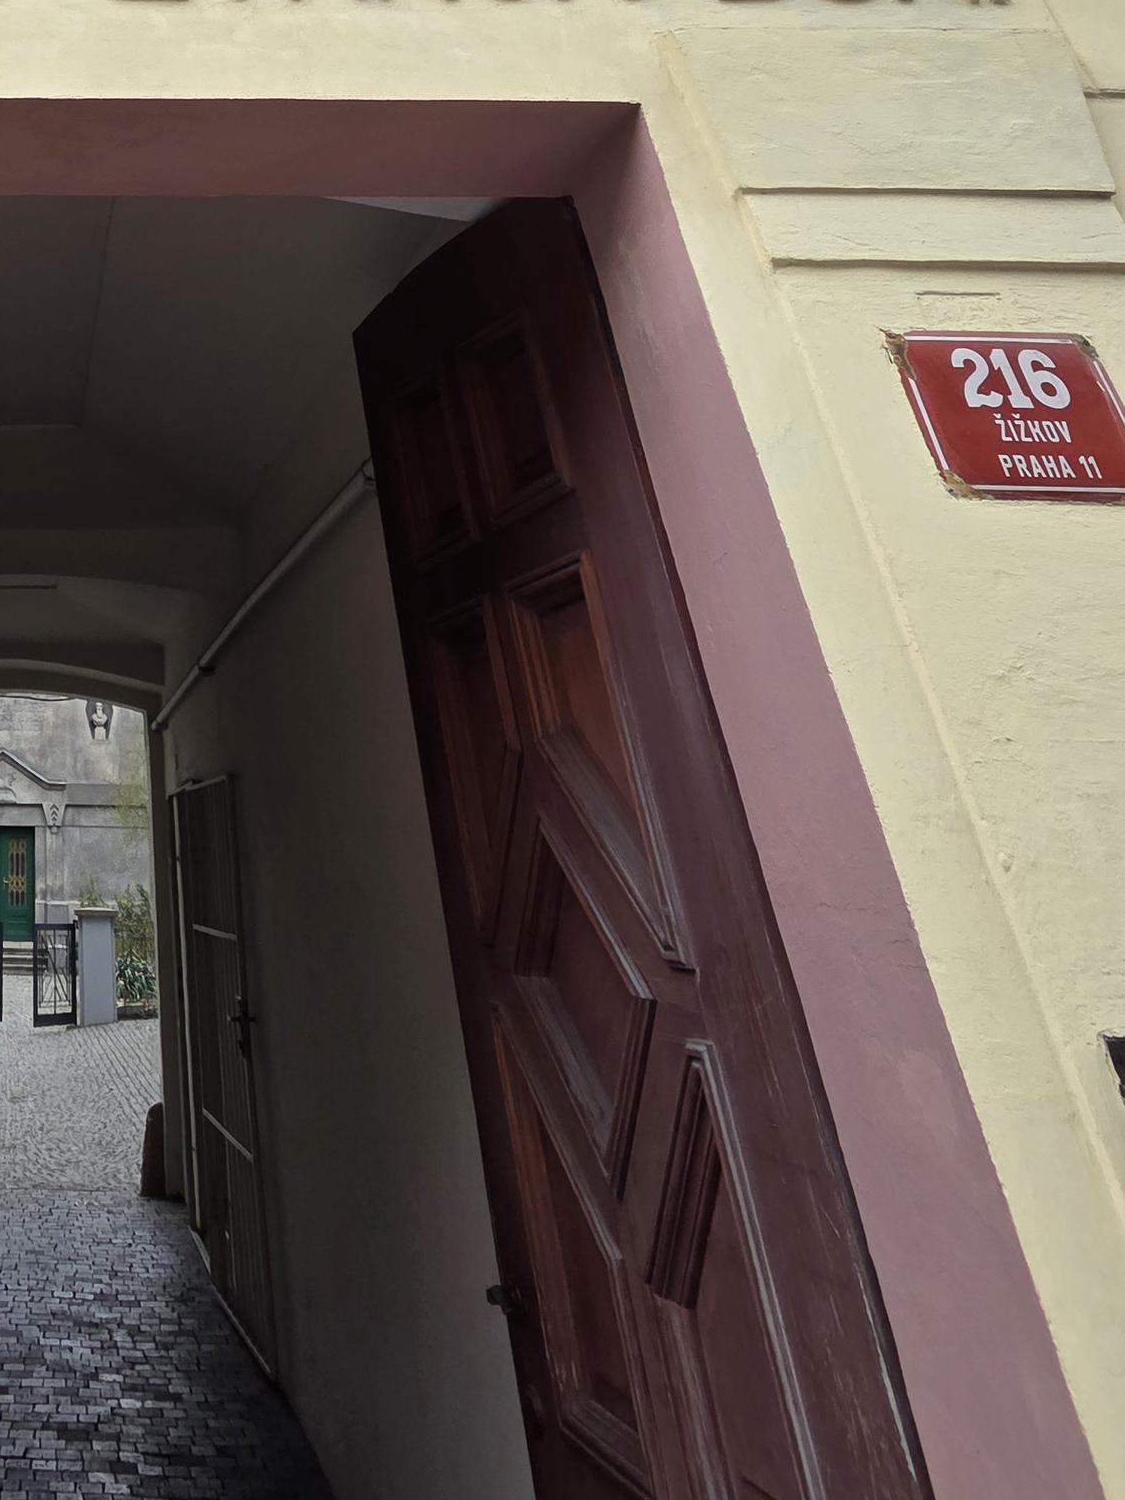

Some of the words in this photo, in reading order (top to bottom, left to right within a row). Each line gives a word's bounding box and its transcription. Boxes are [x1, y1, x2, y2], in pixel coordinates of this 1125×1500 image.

[951, 348, 1071, 410] 216
[994, 413, 1072, 443] ŽIŽKOV
[998, 454, 1077, 479] PRAHA
[1079, 455, 1103, 480] 11
